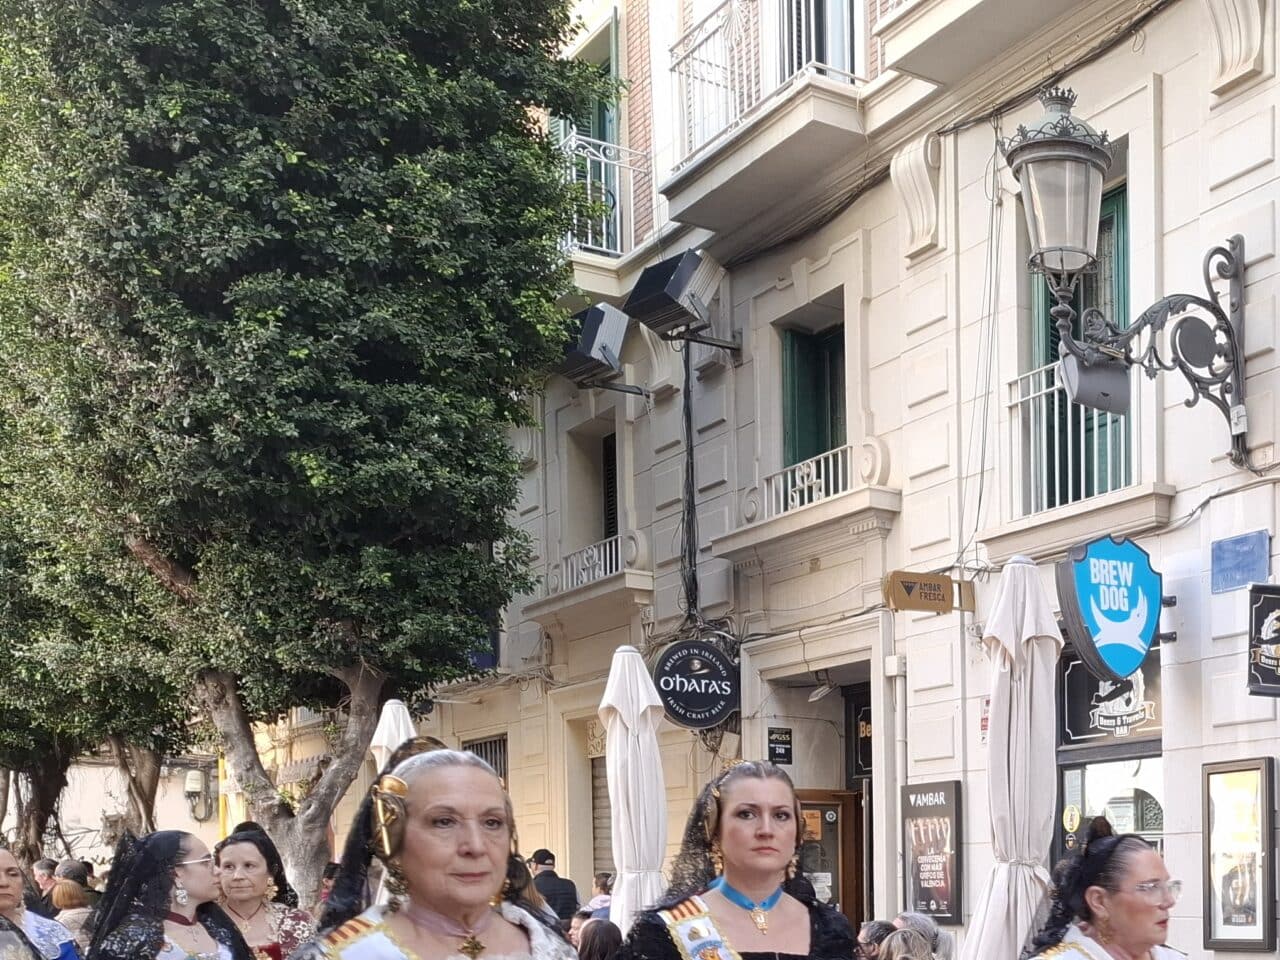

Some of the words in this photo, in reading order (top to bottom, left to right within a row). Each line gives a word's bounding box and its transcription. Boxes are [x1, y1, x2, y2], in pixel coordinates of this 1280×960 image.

[1090, 558, 1134, 587] BREW
[1100, 585, 1129, 611] DOG
[664, 649, 688, 671] BREWED
[701, 650, 727, 677] IRELAND
[667, 696, 685, 715] IRISH
[686, 711, 710, 719] CRAFT
[711, 700, 726, 715] BEER
[916, 792, 946, 807] AMBAR
